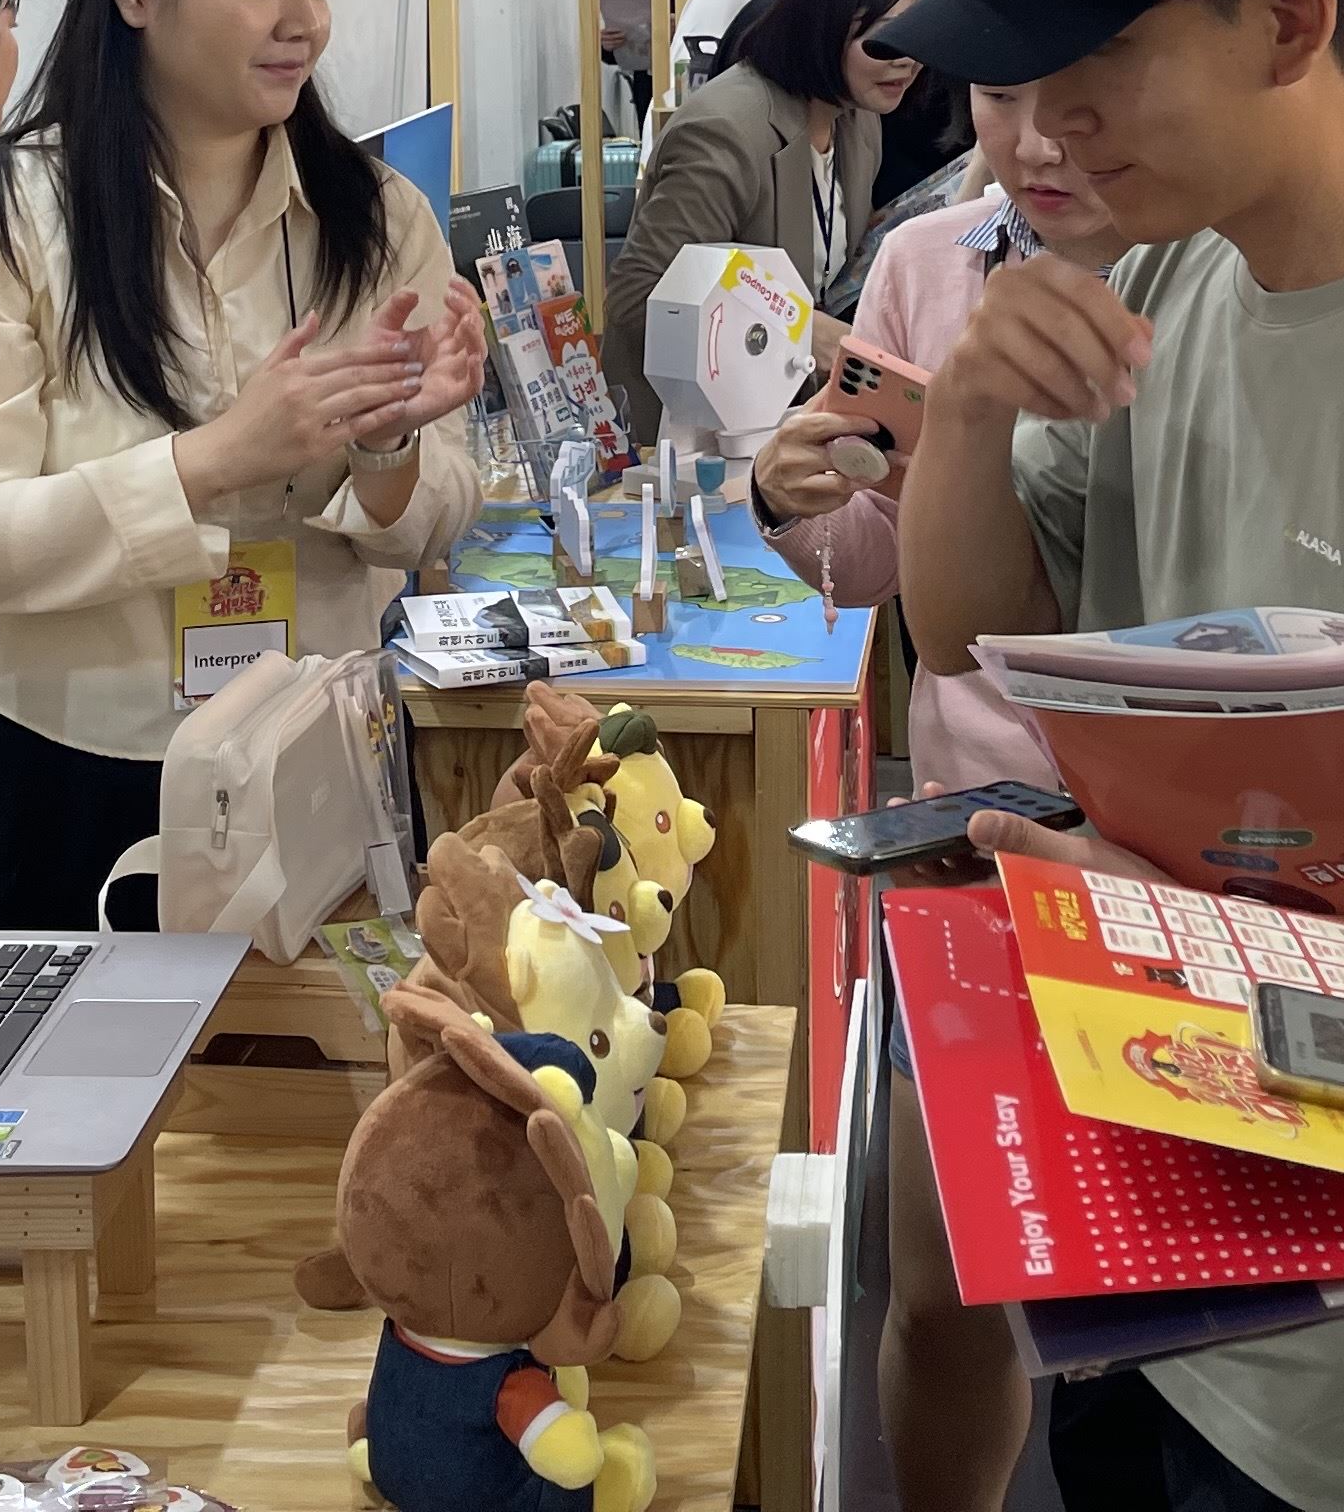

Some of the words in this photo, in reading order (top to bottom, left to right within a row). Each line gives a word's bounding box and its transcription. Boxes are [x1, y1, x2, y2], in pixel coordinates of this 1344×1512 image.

[995, 1092, 1020, 1150] Stay
[1010, 1153, 1036, 1208] Your
[1023, 1208, 1054, 1277] Enjoy
